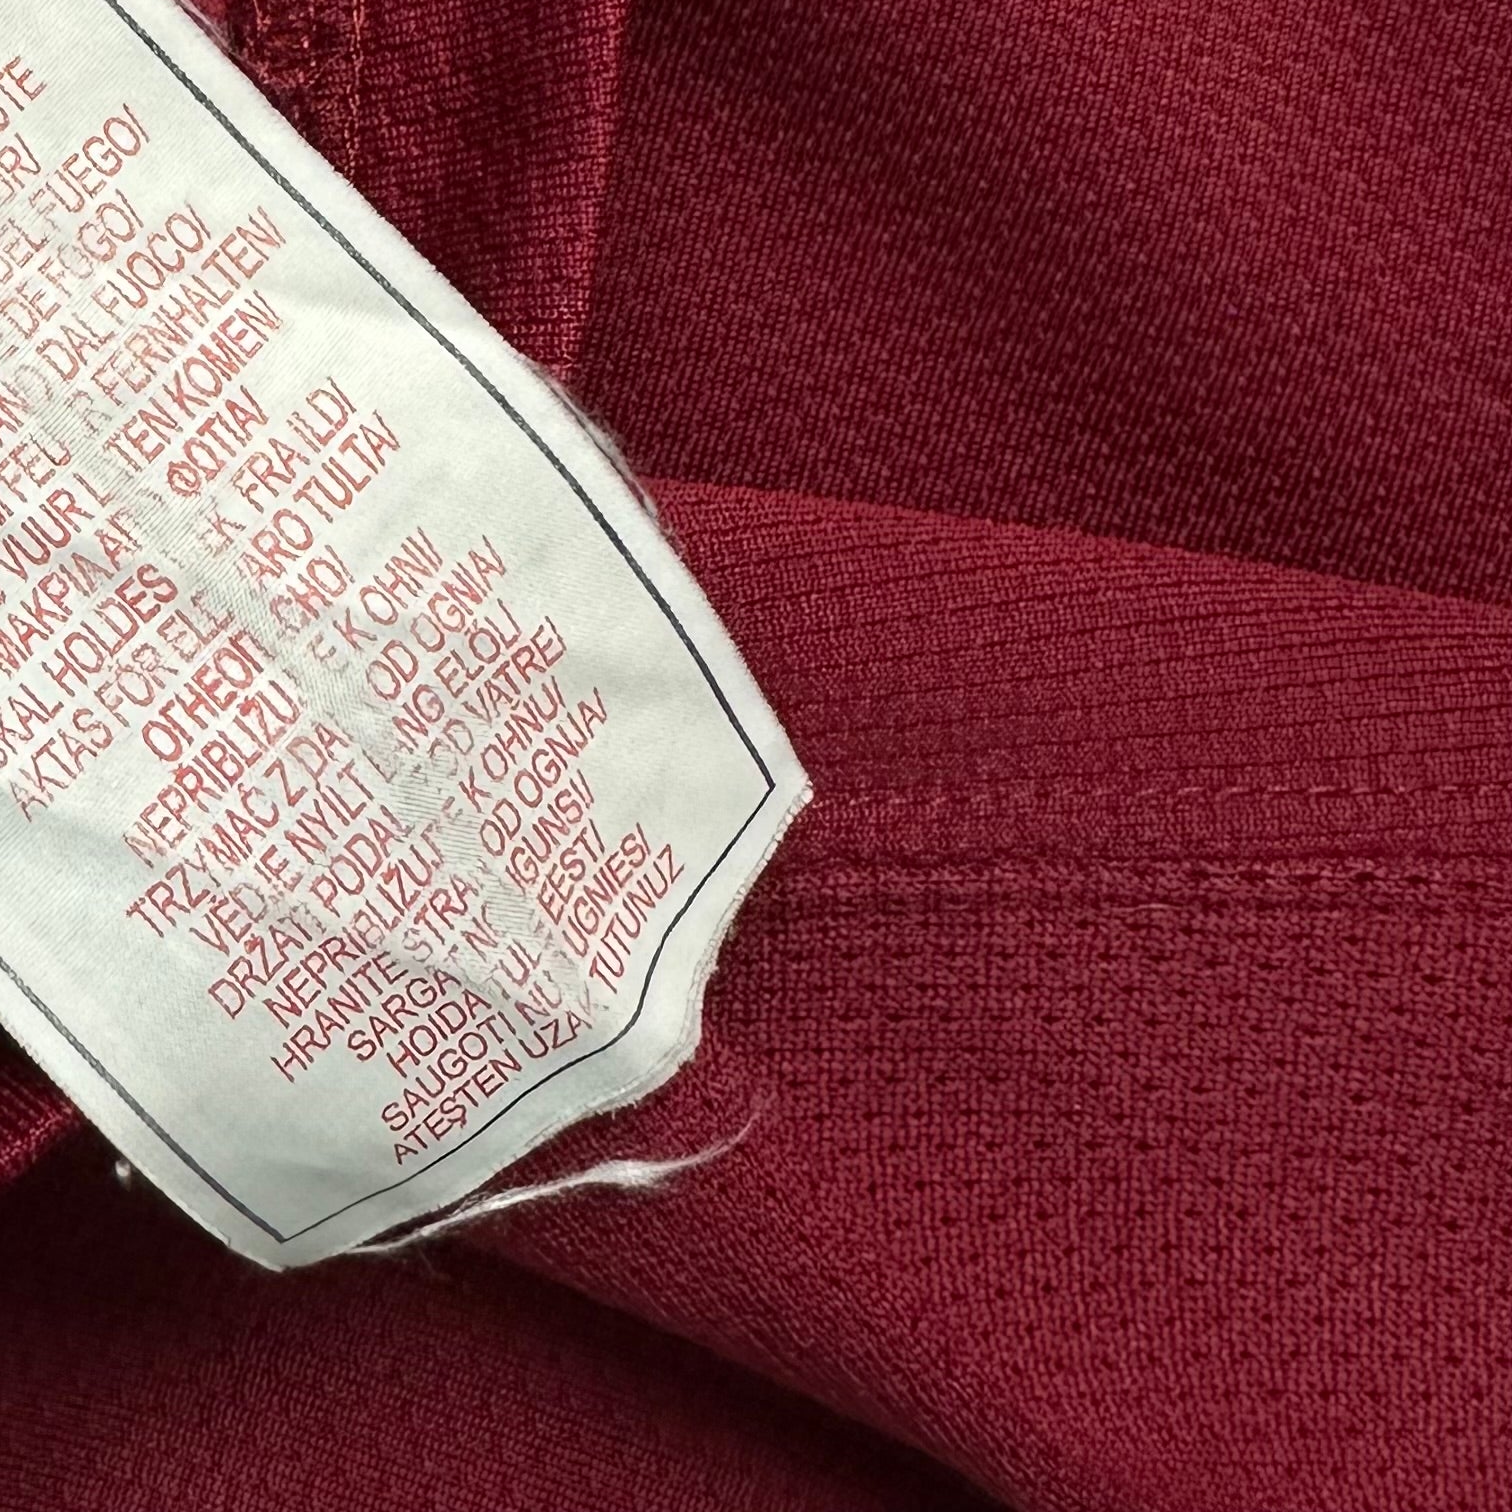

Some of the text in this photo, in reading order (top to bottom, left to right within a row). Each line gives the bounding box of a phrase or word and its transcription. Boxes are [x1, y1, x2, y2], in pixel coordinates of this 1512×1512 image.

[29, 103, 149, 229] FUEGO/
[37, 189, 144, 298] FOGO/
[36, 318, 116, 381] DAL
[92, 204, 211, 325] FUOCO/
[91, 207, 285, 406] FERNHALTEN/
[163, 291, 278, 418] KOMEN/
[11, 708, 113, 822] AKTAS
[94, 643, 178, 727] FÖR
[294, 411, 400, 523] TULTA/
[42, 565, 177, 696] HOLDES
[231, 439, 309, 513] FRA
[332, 608, 377, 651] K
[126, 783, 279, 937] TRZYMAĆ
[264, 758, 308, 807] Z
[366, 640, 418, 700] OD
[411, 536, 506, 652] OGNIA/
[462, 616, 566, 722] VATRE/
[458, 766, 491, 813] K
[271, 951, 408, 1082] HRANITE
[480, 798, 521, 856] OD
[514, 688, 606, 808] OGNJA/
[387, 989, 491, 1078] HOIDA
[537, 820, 604, 925] EEST/
[589, 844, 684, 994] TUTUNUZ
[382, 1011, 516, 1131] SAUGOTI
[563, 824, 650, 957] UGNIES/
